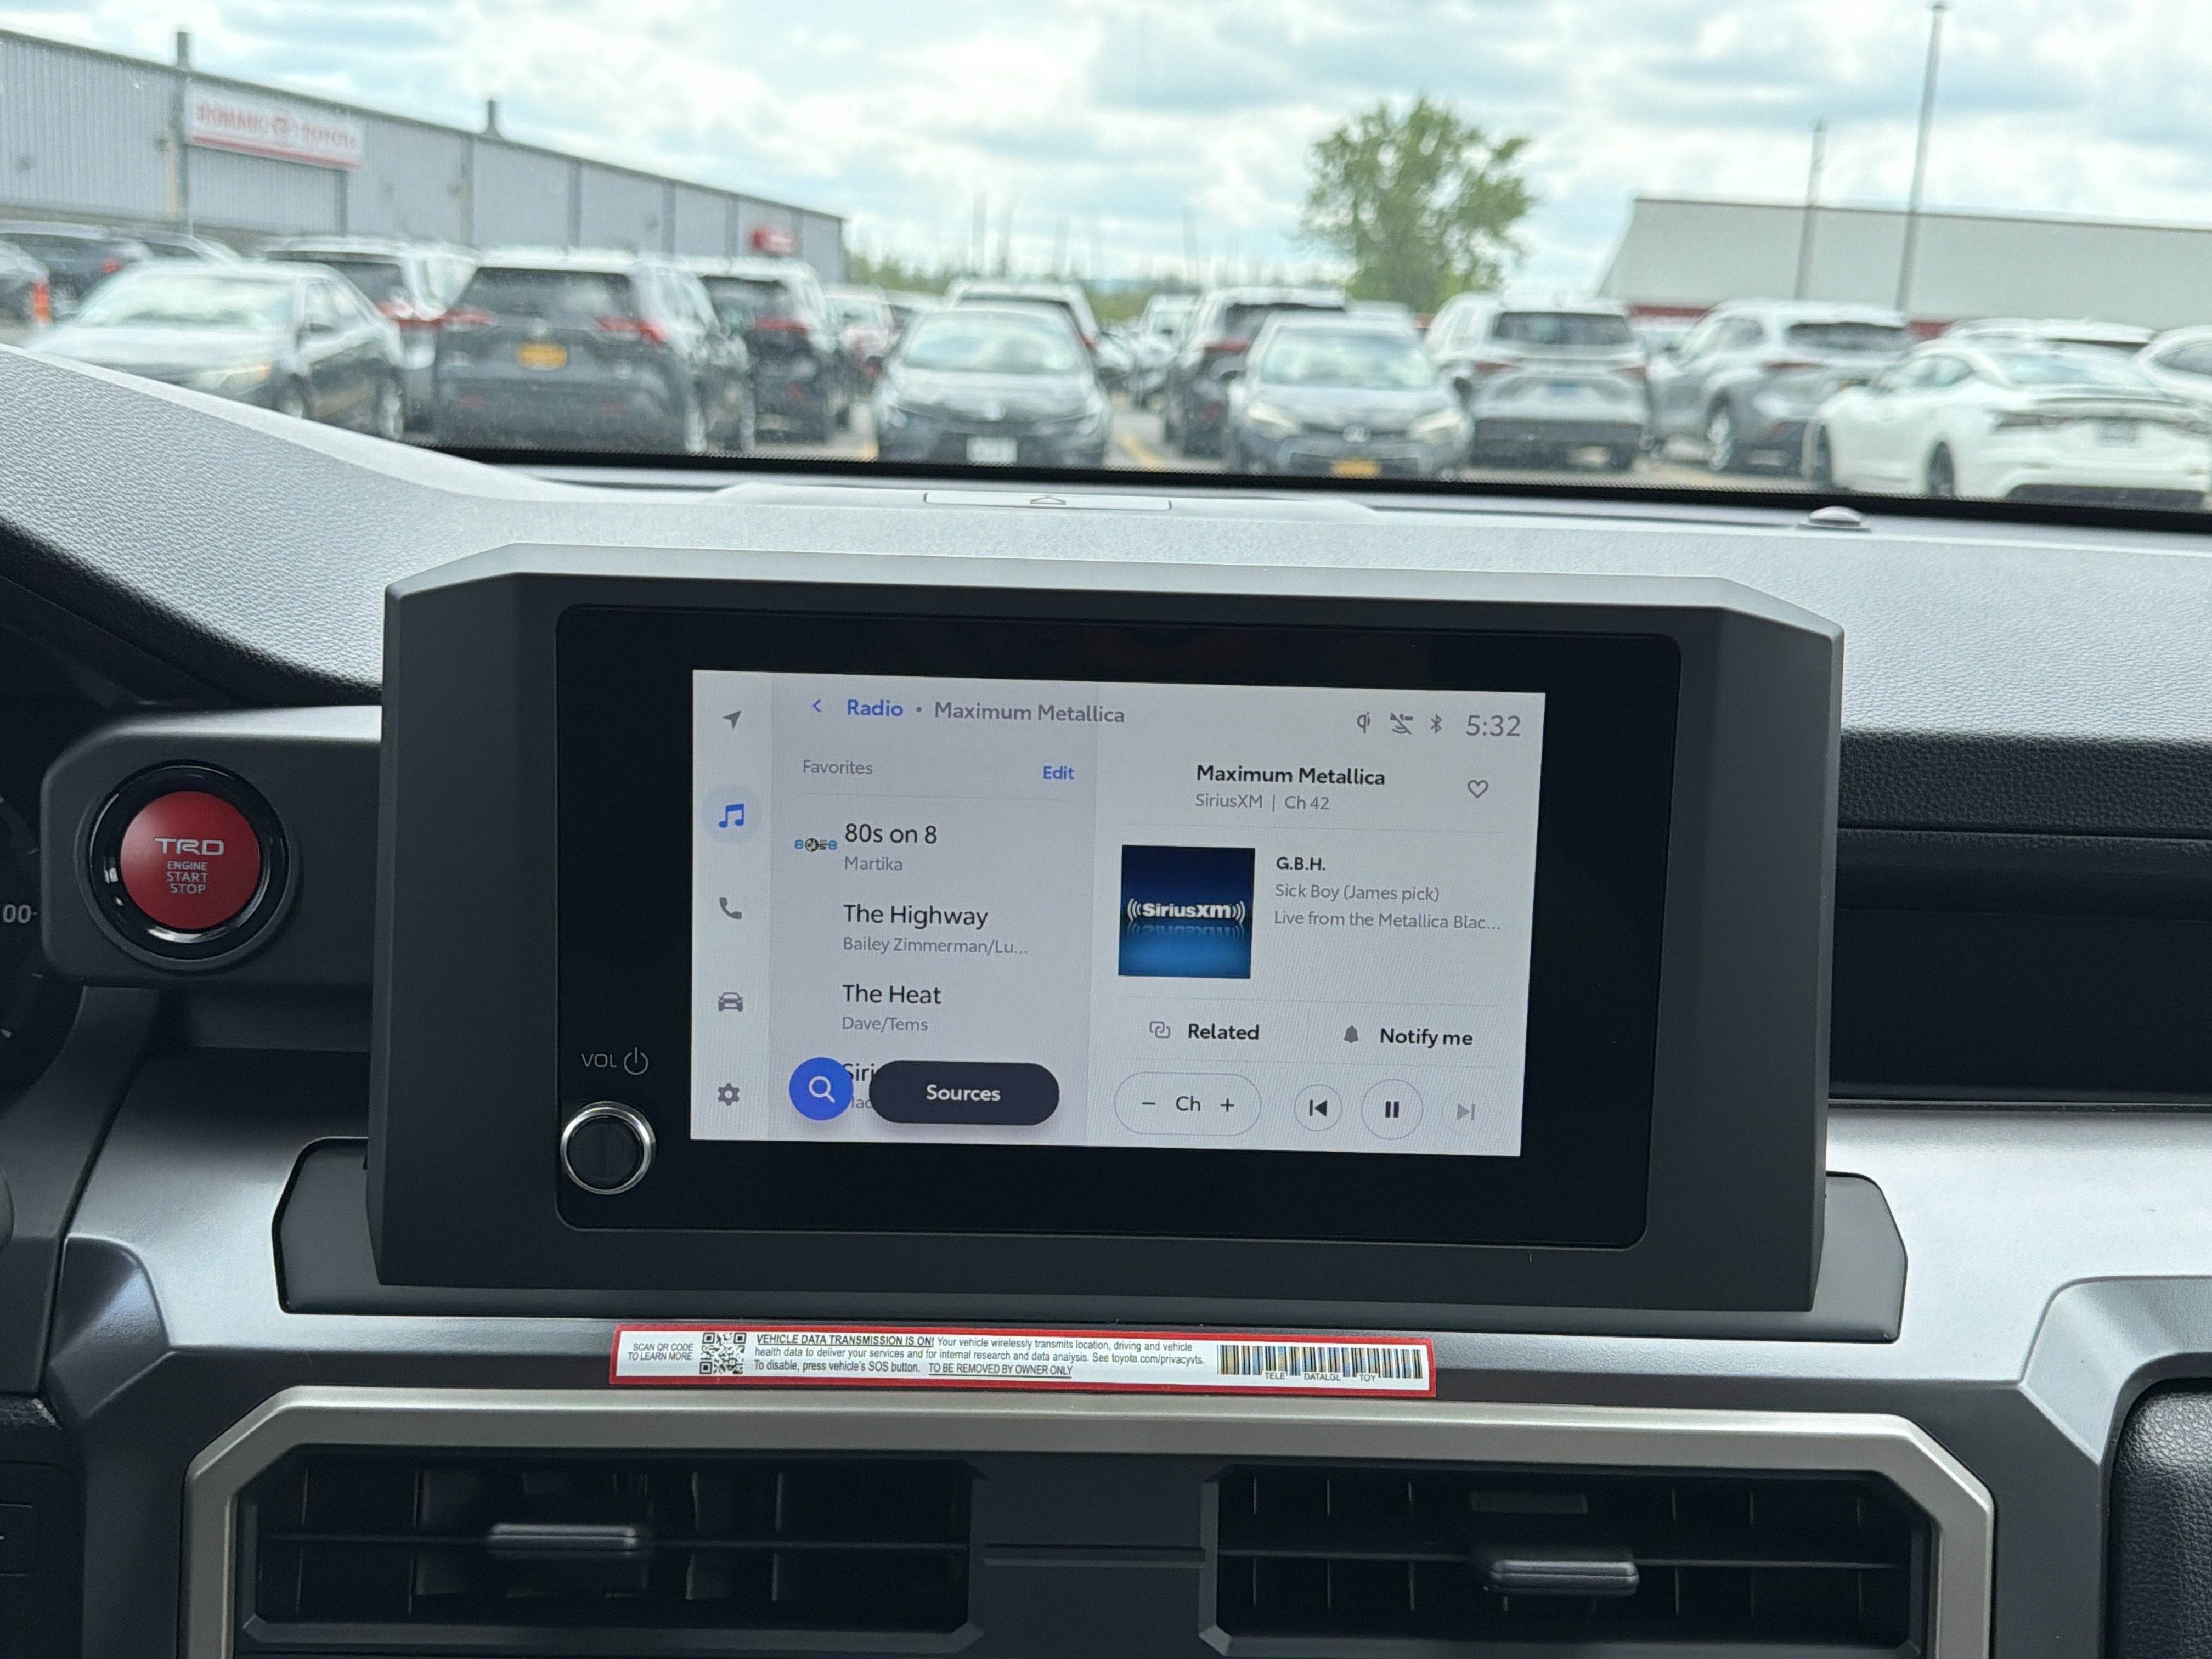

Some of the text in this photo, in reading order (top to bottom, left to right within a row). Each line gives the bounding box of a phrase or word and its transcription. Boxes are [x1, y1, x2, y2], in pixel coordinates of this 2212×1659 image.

[847, 699, 1125, 724] Radio Maximum Metallica
[1466, 714, 1522, 738] 5:32
[803, 759, 873, 776] Favorites
[1043, 766, 1075, 781] Edit
[1197, 765, 1385, 786] Maximum Metallica
[1195, 793, 1263, 809] SiriusXM
[1284, 795, 1307, 810] Ch
[1310, 796, 1330, 810] 42
[845, 823, 938, 845] 80s on 8
[154, 838, 225, 855] TRD
[167, 861, 208, 871] ENGINE
[844, 856, 903, 871] Martika
[1276, 857, 1326, 872] G.B.H.
[167, 872, 208, 882] START
[170, 883, 207, 894] STOP
[1275, 884, 1440, 904] Sick Boy (James pick)
[843, 904, 989, 930] The Highway
[1274, 912, 1501, 930] Live from the Metallica Blac...
[843, 936, 1028, 956] Bailey Zimmerman/Lu...
[843, 984, 942, 1005] The Heat
[842, 1017, 928, 1034] Dave/Tems
[1188, 1024, 1259, 1041] Related
[1380, 1028, 1473, 1048] Notify me
[581, 1053, 617, 1068] VOL
[926, 1084, 1001, 1102] Sources
[1176, 1096, 1201, 1113] Ch
[757, 1334, 798, 1344] VEHICLE
[802, 1335, 826, 1344] DATA
[830, 1336, 902, 1345] TRANSMISSION
[917, 1337, 934, 1346] ON!
[938, 1338, 956, 1346] Your
[991, 1339, 1032, 1350] wirelessly
[1035, 1340, 1073, 1349] transmits
[1076, 1340, 1110, 1350] location,
[1114, 1341, 1141, 1352] driving
[1145, 1342, 1160, 1351] and
[1163, 1343, 1192, 1351] vehicle
[755, 1347, 1204, 1367] health data to deliver your services and for internal research and data analysis. See toyota.com/privacyvts.
[754, 1360, 1073, 1375] To disable, press vehicle's SOS button. TO BE REMOVED BY OWNER ONLY
[1304, 1373, 1341, 1381] DATALGL
[1359, 1374, 1376, 1382] TOY
